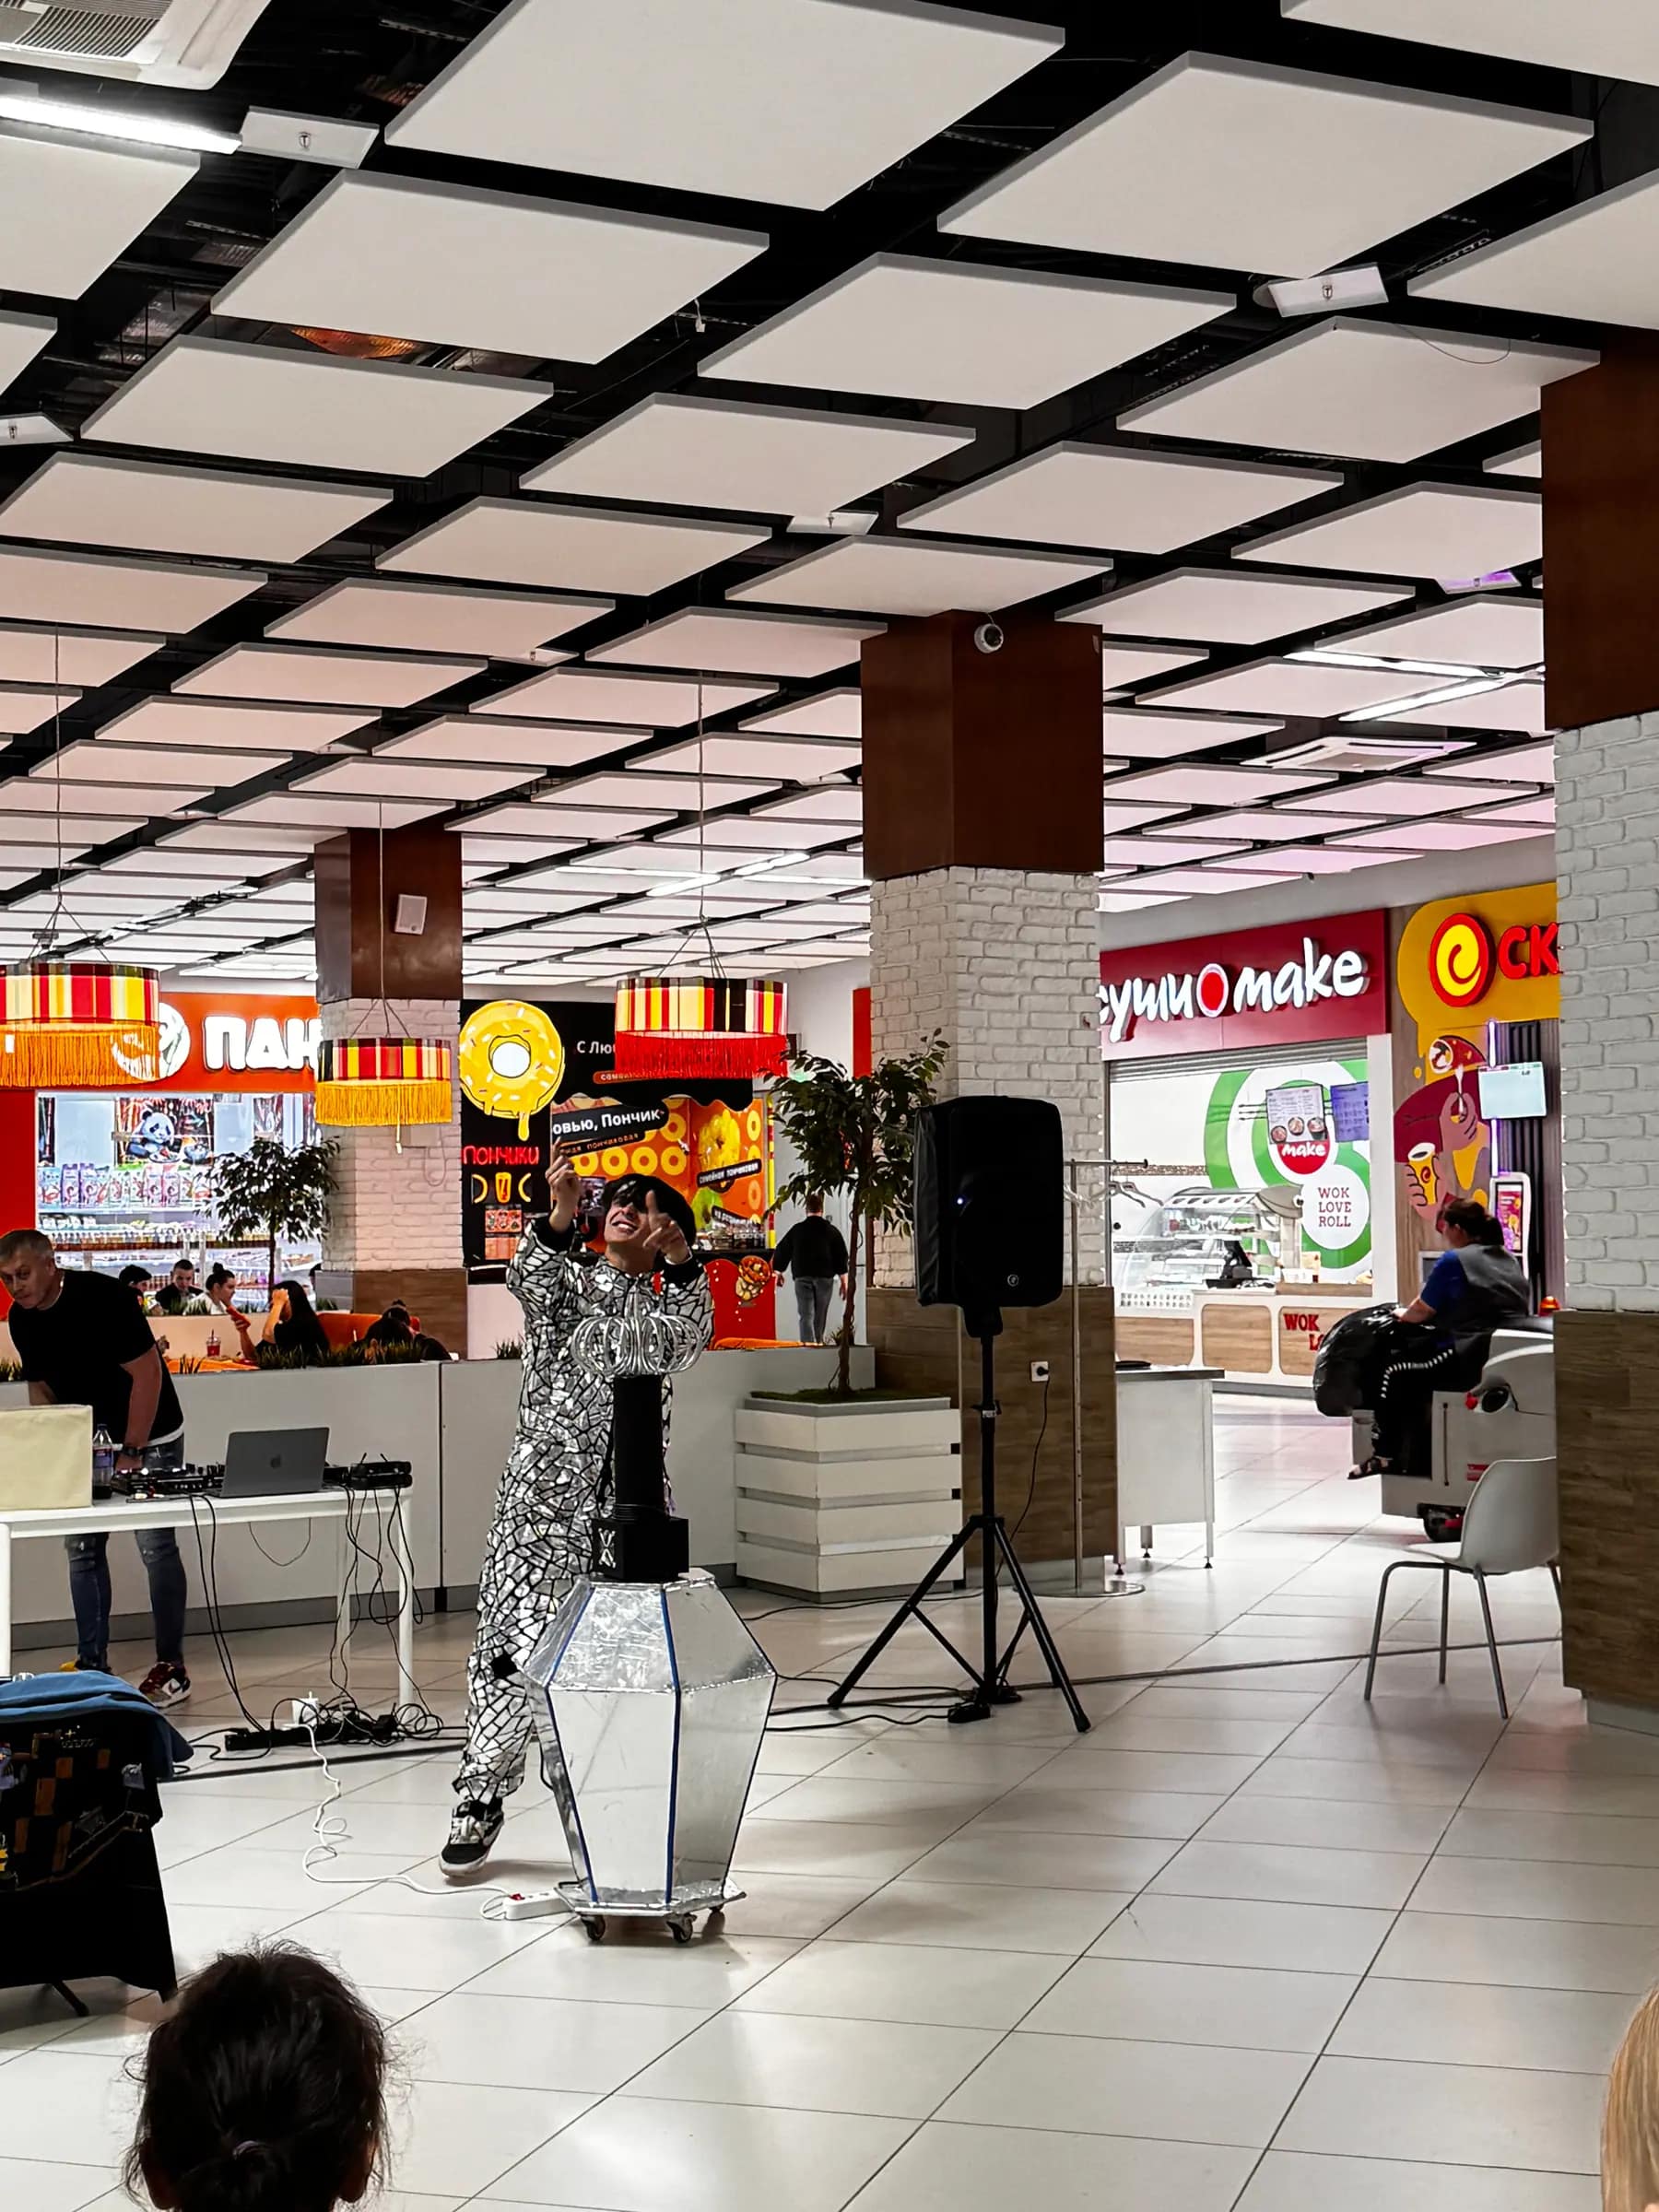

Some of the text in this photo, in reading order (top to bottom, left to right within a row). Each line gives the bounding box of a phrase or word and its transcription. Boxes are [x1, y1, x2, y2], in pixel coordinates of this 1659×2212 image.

[1233, 936, 1366, 1013] make
[601, 1109, 661, 1127] Пончик
[1281, 1143, 1326, 1158] make
[1318, 1187, 1349, 1198] WOK
[1319, 1202, 1351, 1213] LOVE
[1319, 1216, 1351, 1227] ROLL
[1283, 1313, 1320, 1332] WOK
